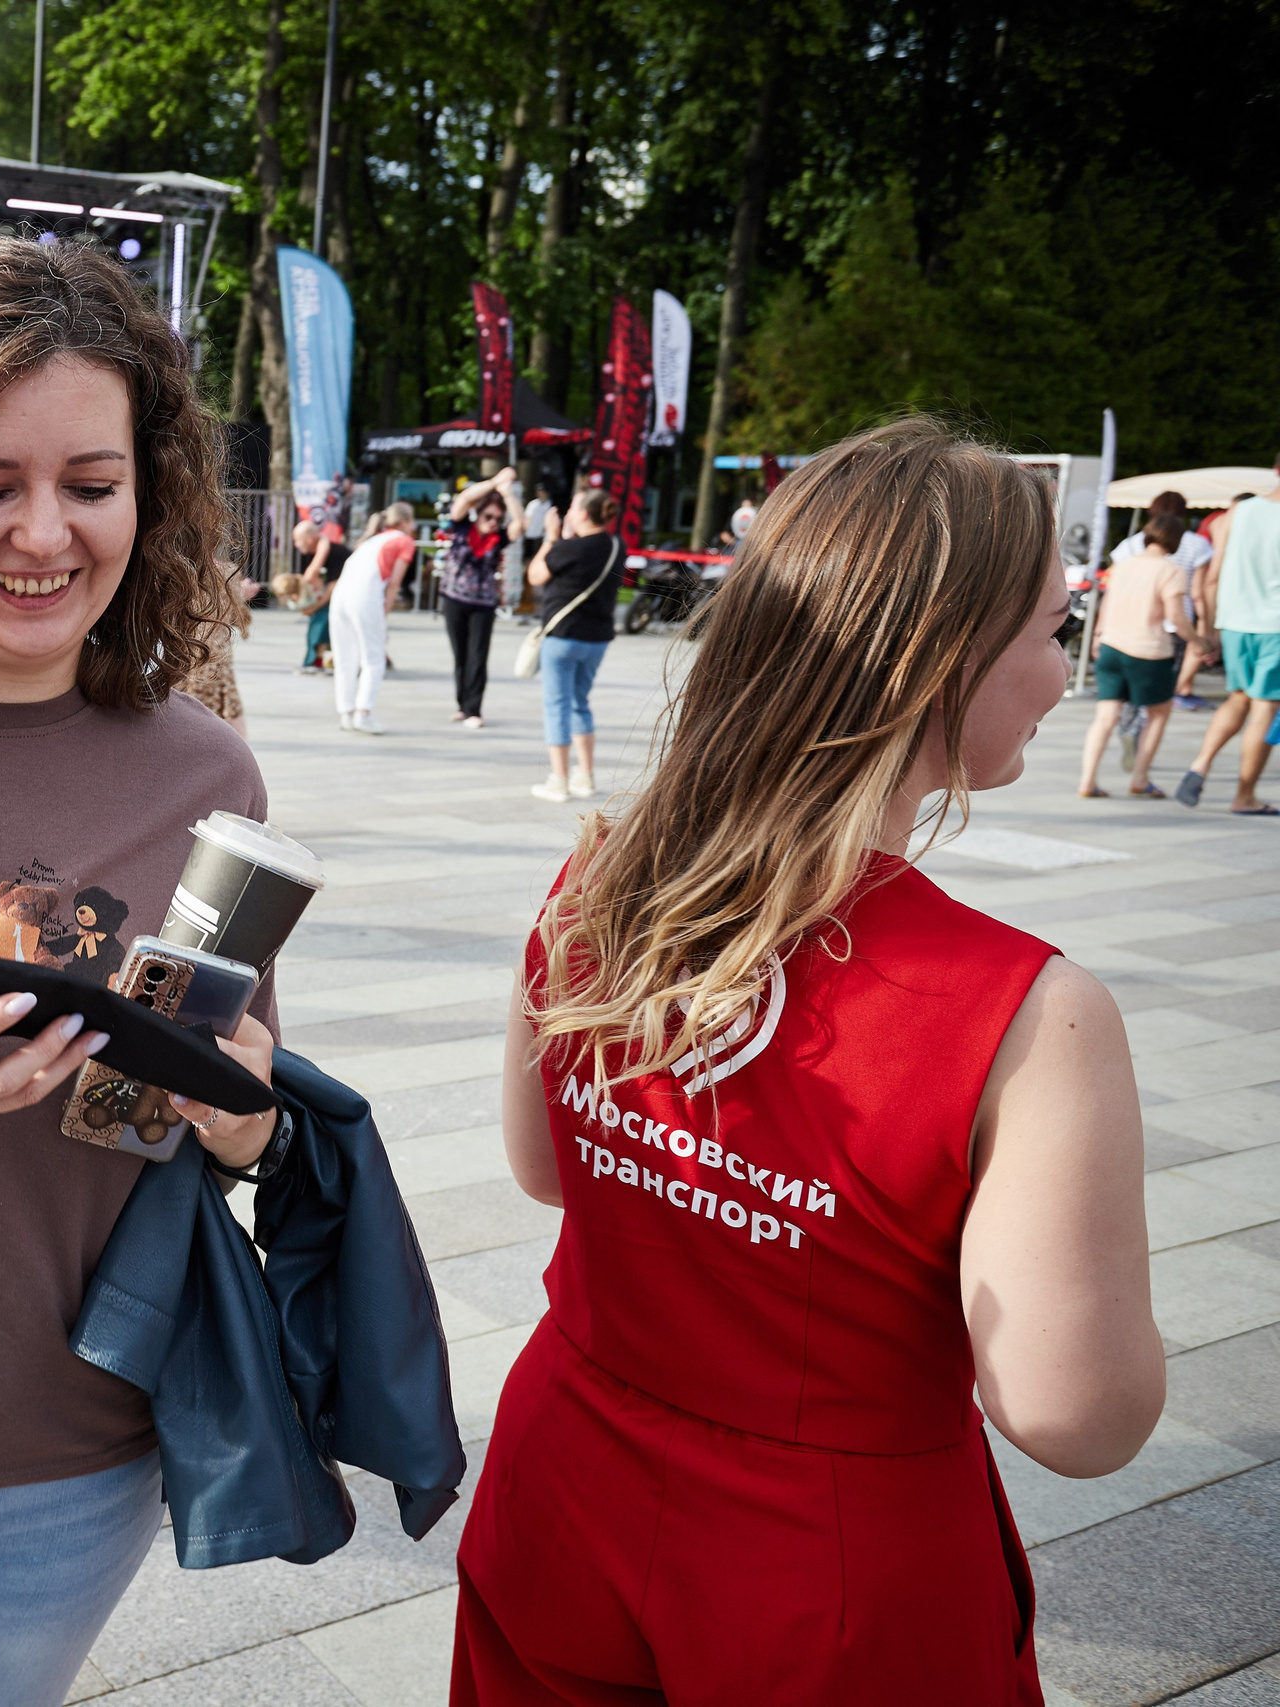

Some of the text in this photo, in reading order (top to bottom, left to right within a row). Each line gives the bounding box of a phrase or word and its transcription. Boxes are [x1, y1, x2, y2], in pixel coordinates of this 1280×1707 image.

[19, 864, 41, 884] teddy
[31, 857, 55, 876] Brown
[561, 1074, 837, 1219] Московский
[575, 1135, 807, 1250] транспорт
